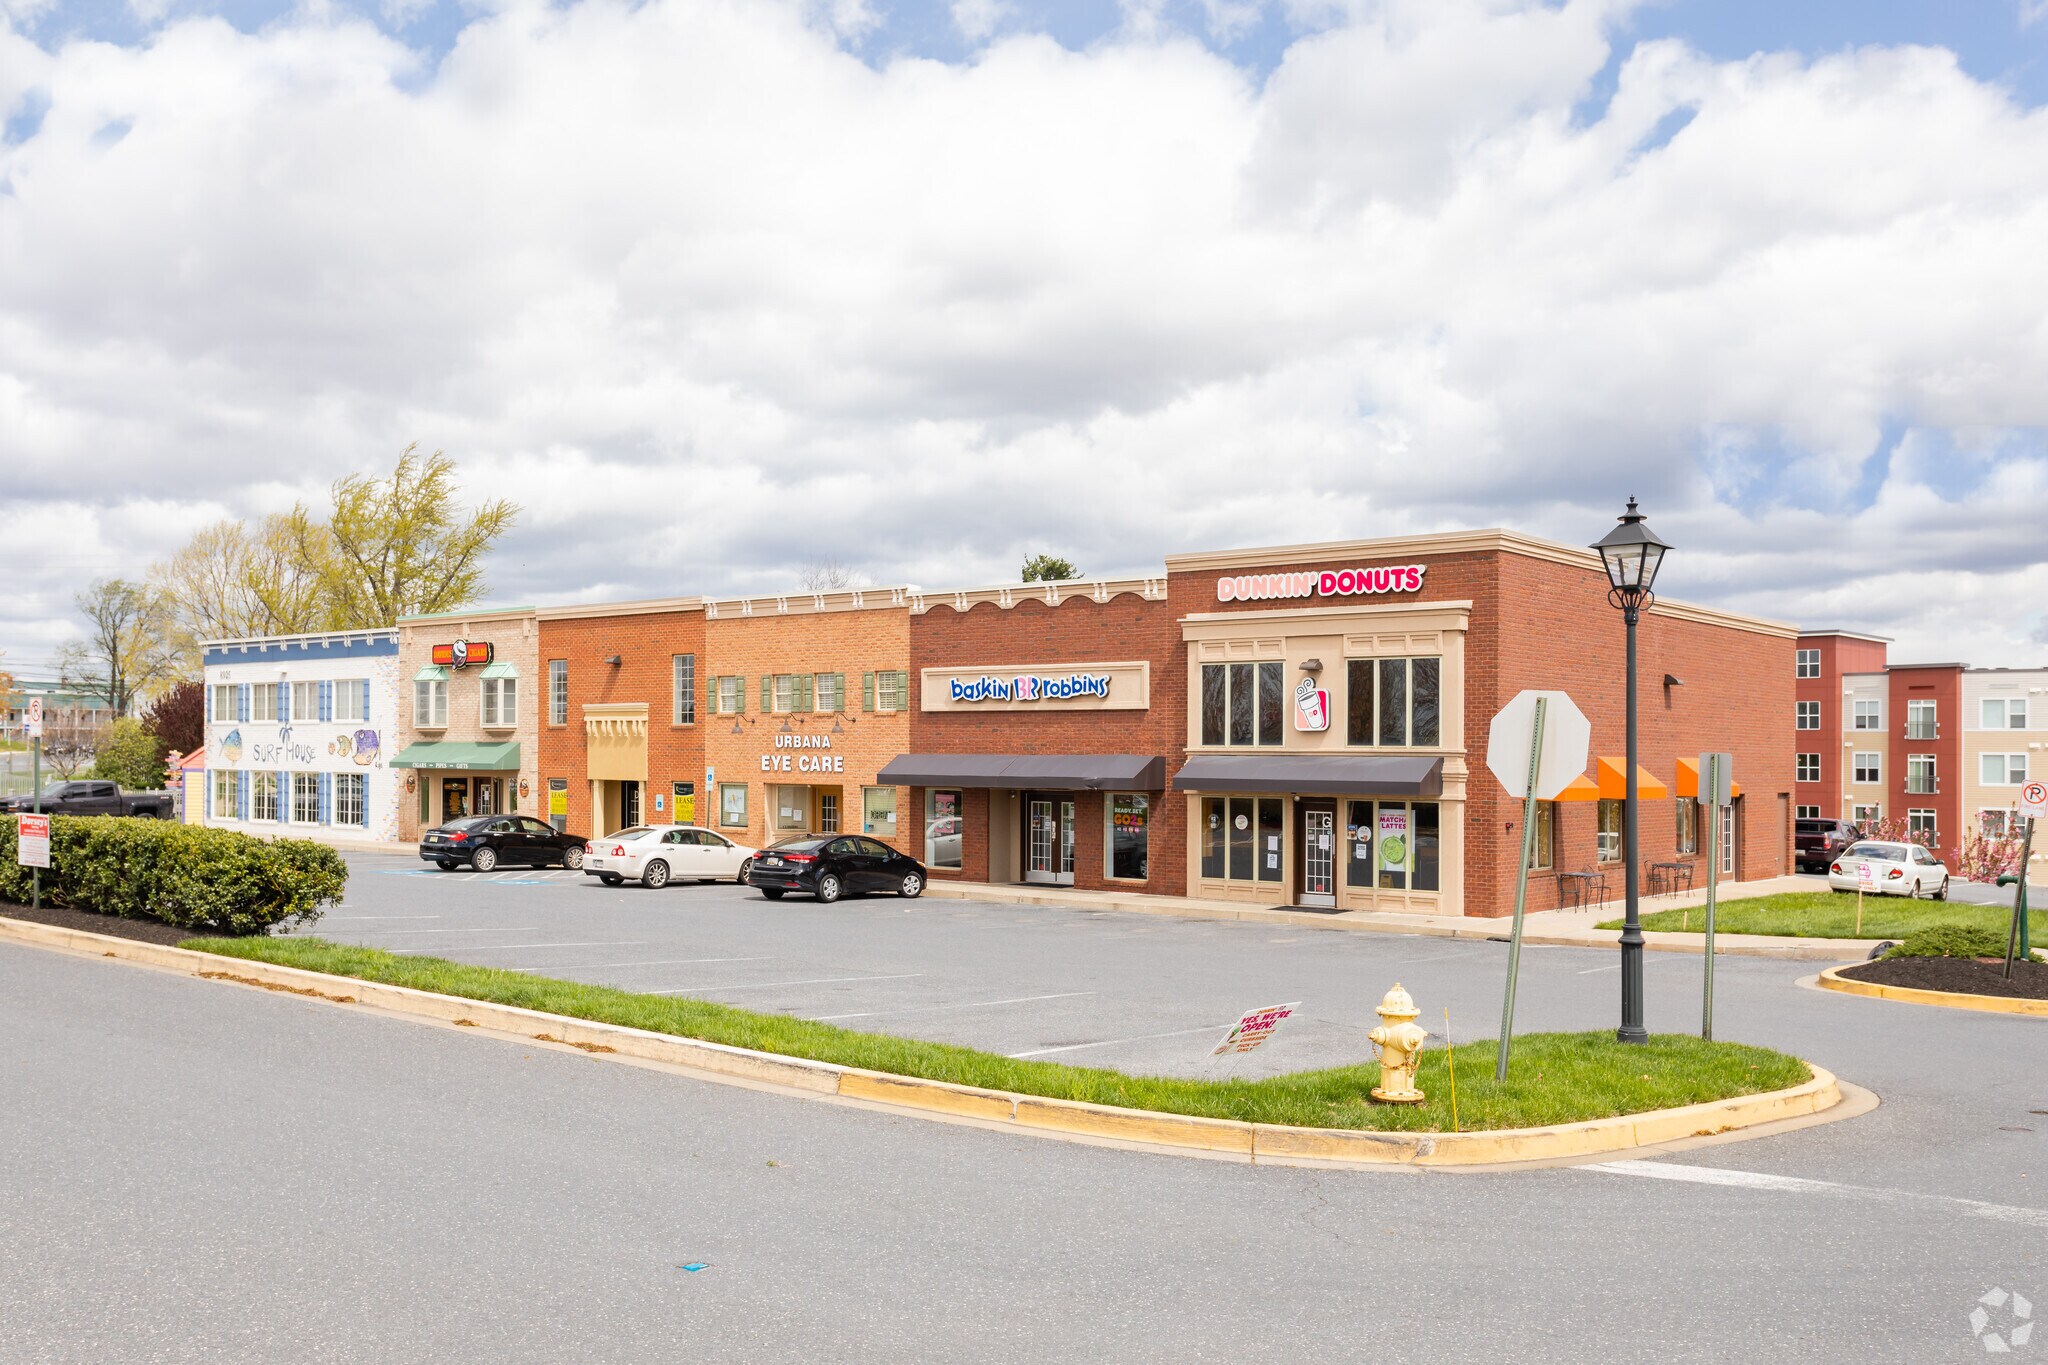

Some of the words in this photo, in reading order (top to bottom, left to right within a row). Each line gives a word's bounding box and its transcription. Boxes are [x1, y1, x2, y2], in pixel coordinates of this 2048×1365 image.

[1219, 571, 1317, 600] DUNKIN'
[1320, 567, 1420, 594] DONUTS
[468, 647, 487, 657] CIGARS
[950, 676, 1010, 700] baskin
[1043, 674, 1106, 697] robbins
[775, 735, 831, 748] URBANA
[253, 743, 282, 764] SURF
[285, 741, 316, 764] HOUSE
[761, 754, 792, 771] EYE
[798, 755, 844, 773] CARE
[551, 791, 568, 799] LEASE
[675, 796, 694, 804] LEASE
[1322, 816, 1331, 828] G
[1261, 1010, 1293, 1021] WE'RE
[1240, 1020, 1277, 1033] OPEN!
